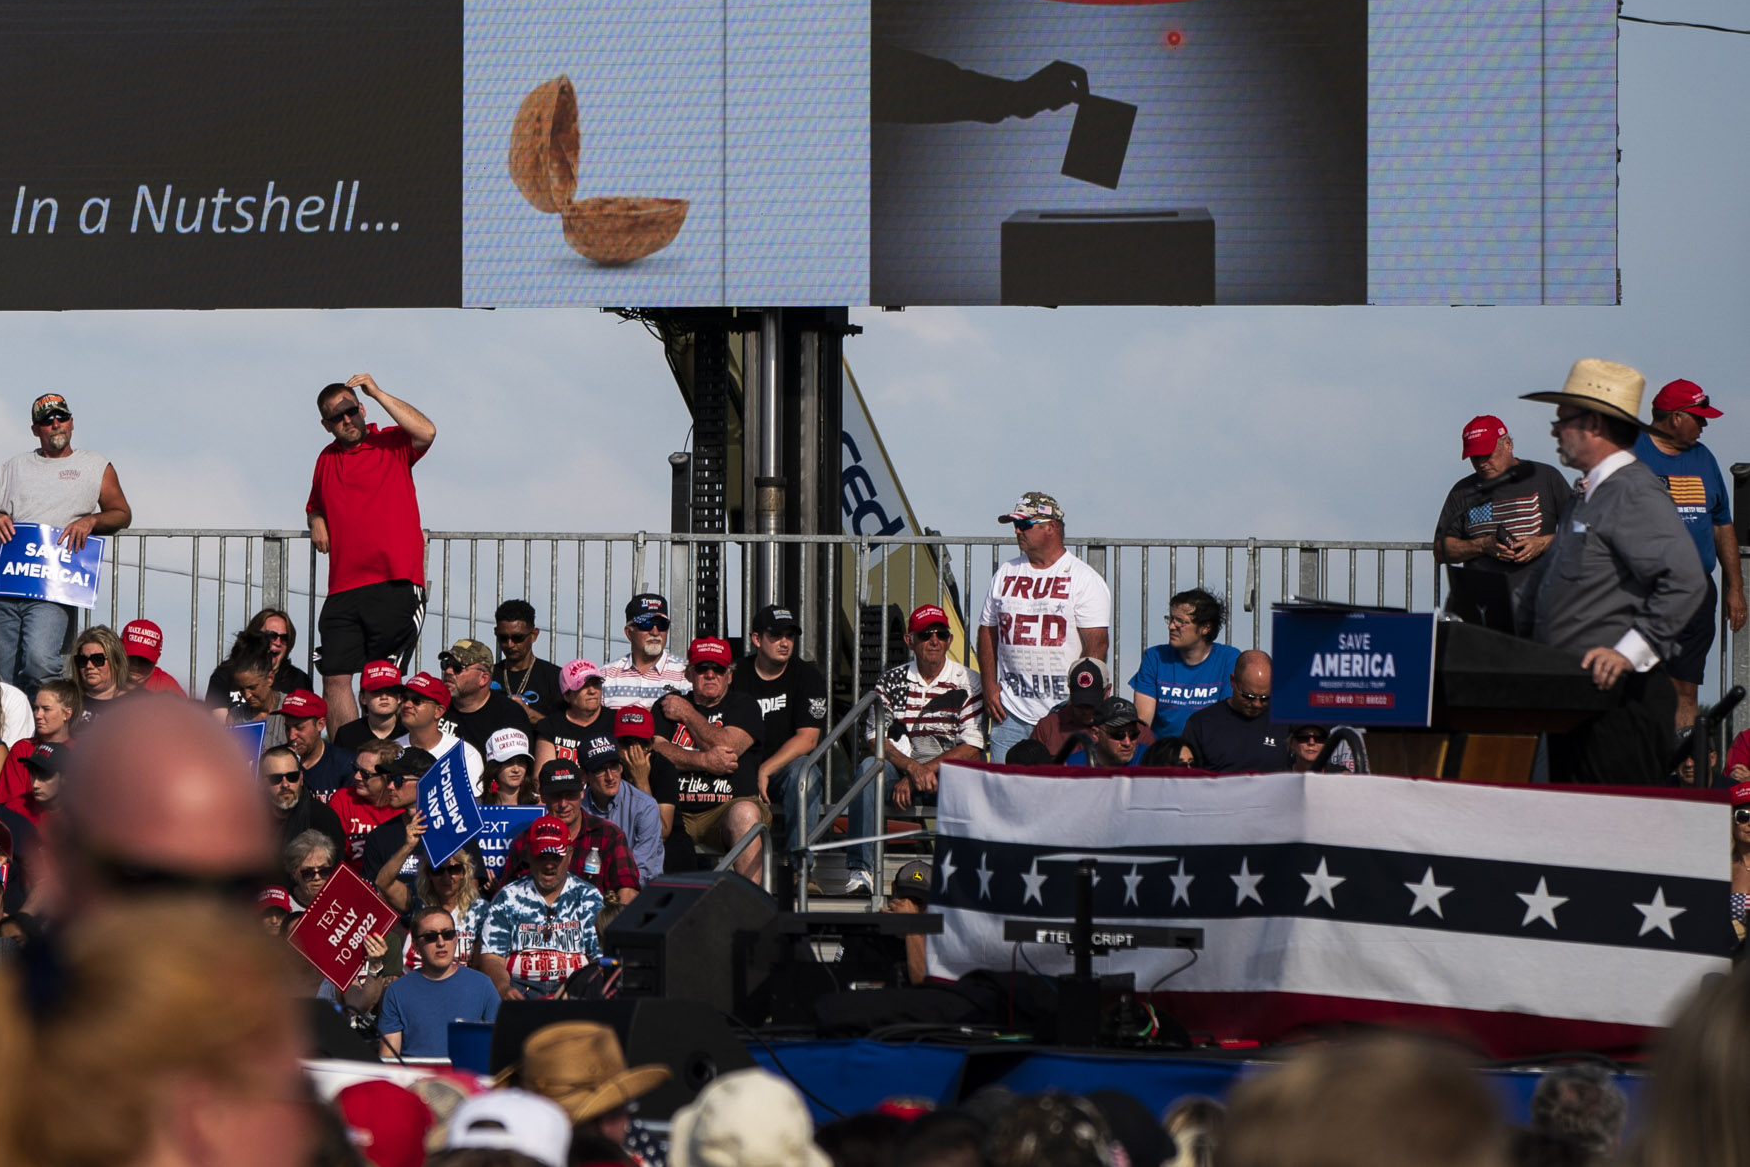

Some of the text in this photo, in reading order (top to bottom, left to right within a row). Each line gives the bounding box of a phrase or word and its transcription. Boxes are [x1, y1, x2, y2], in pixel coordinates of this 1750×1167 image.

[10, 180, 400, 235] In a Nutshell...
[25, 543, 73, 563] SAVE
[3, 562, 90, 587] AMERCA!
[1002, 576, 1071, 600] TRUE
[998, 613, 1067, 647] RED
[1338, 633, 1371, 650] SAVE
[1310, 653, 1396, 677] AMERICA
[1160, 686, 1218, 699] TRUMP
[588, 745, 616, 758] STRONG
[590, 737, 610, 748] USA
[688, 777, 710, 793] Like
[713, 778, 733, 794] Me
[440, 758, 467, 833] AMERICA!
[696, 793, 715, 802] WITH
[428, 786, 444, 829] SAVE
[481, 821, 509, 833] EXT
[478, 838, 512, 850] ALLY
[317, 899, 343, 930] TEXT
[328, 907, 358, 947] RALLY
[537, 920, 580, 933] PSIDENT
[335, 912, 377, 965] TO 88022
[519, 928, 581, 952] TRMP
[1050, 931, 1134, 947] TELCRIPT
[521, 956, 584, 972] GREAT!
[540, 969, 567, 978] 2020
